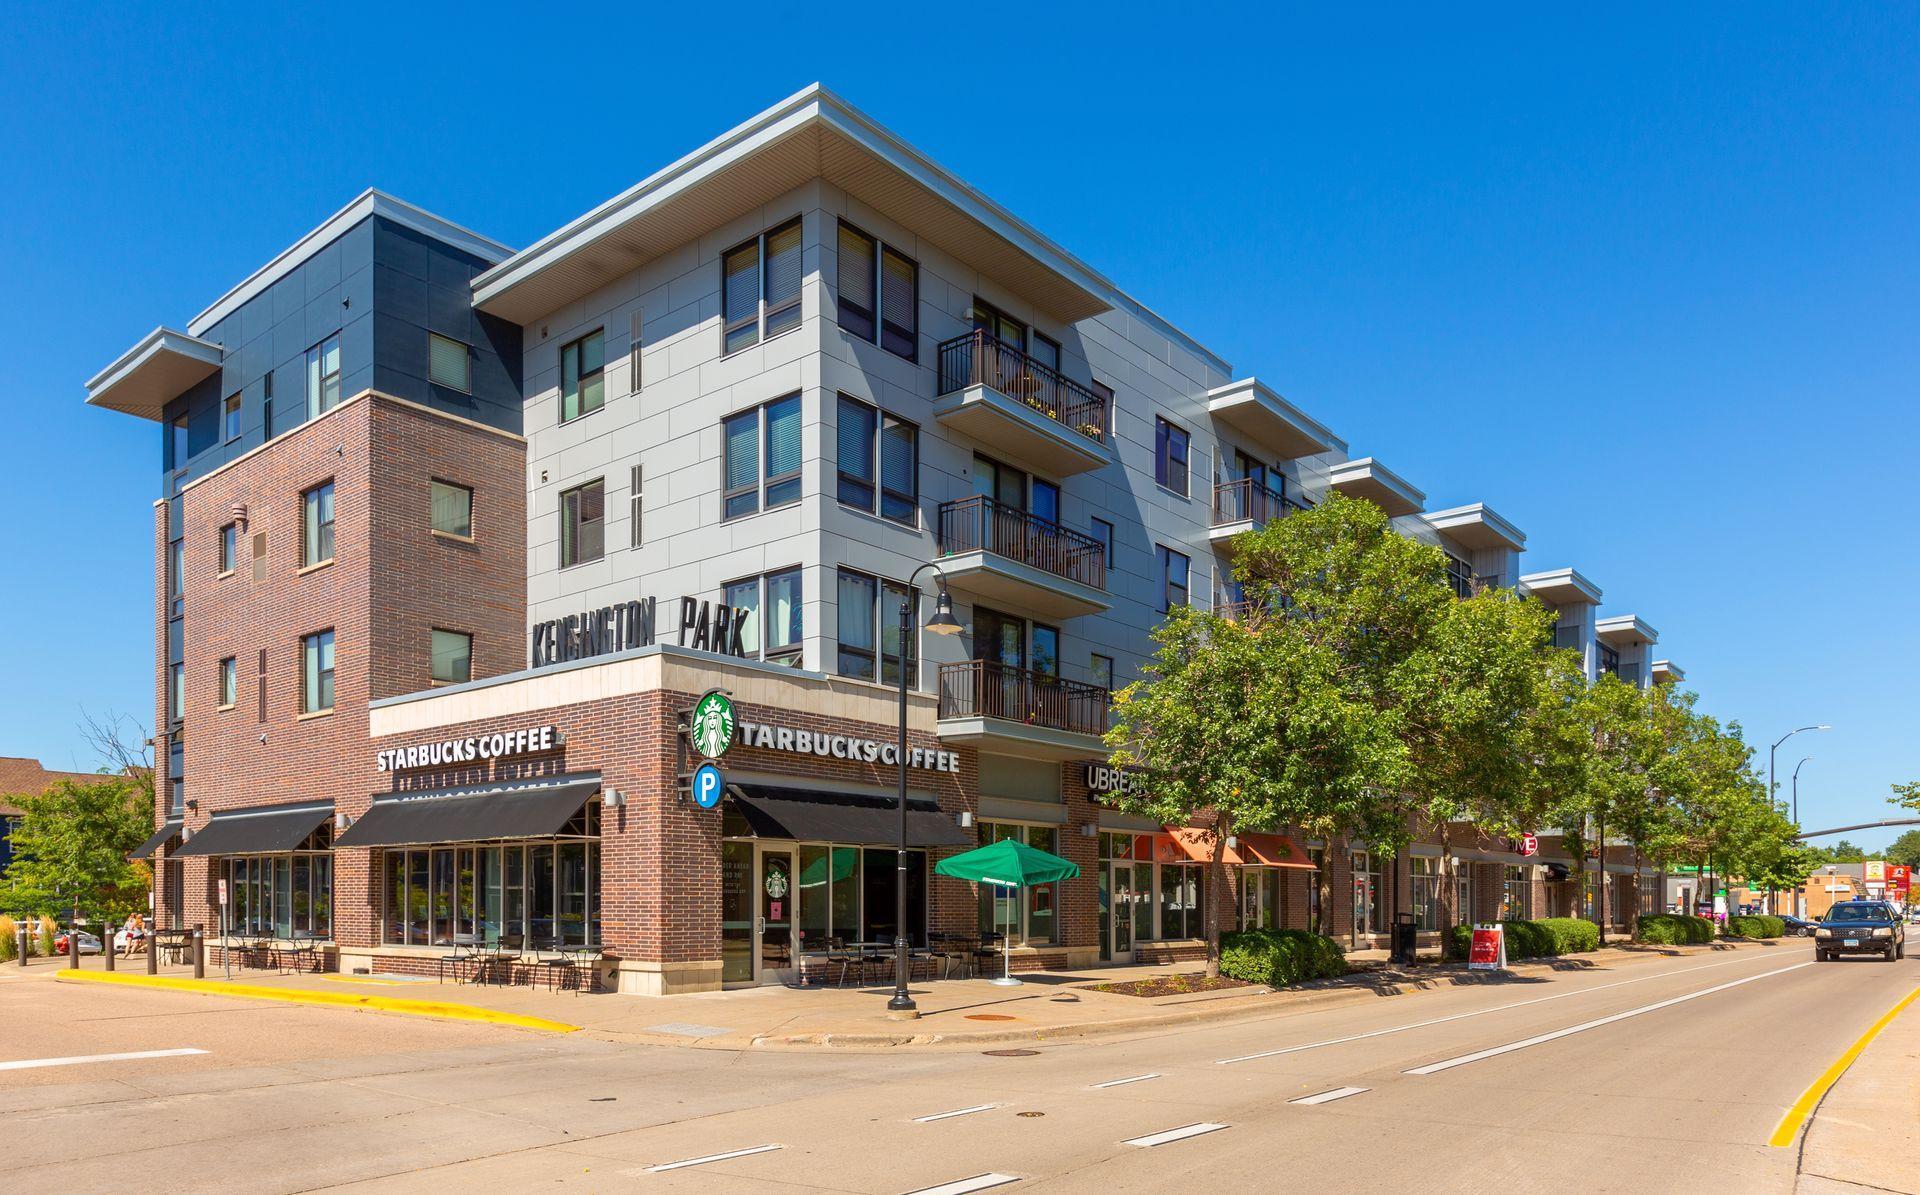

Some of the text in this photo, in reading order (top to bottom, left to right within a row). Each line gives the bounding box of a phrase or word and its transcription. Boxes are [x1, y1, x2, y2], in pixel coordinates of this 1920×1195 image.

[532, 595, 749, 668] KENSINGTON PARK
[377, 726, 553, 772] STARBUCKS COFFEE
[737, 722, 878, 763] TARBUCKS
[701, 772, 716, 802] P
